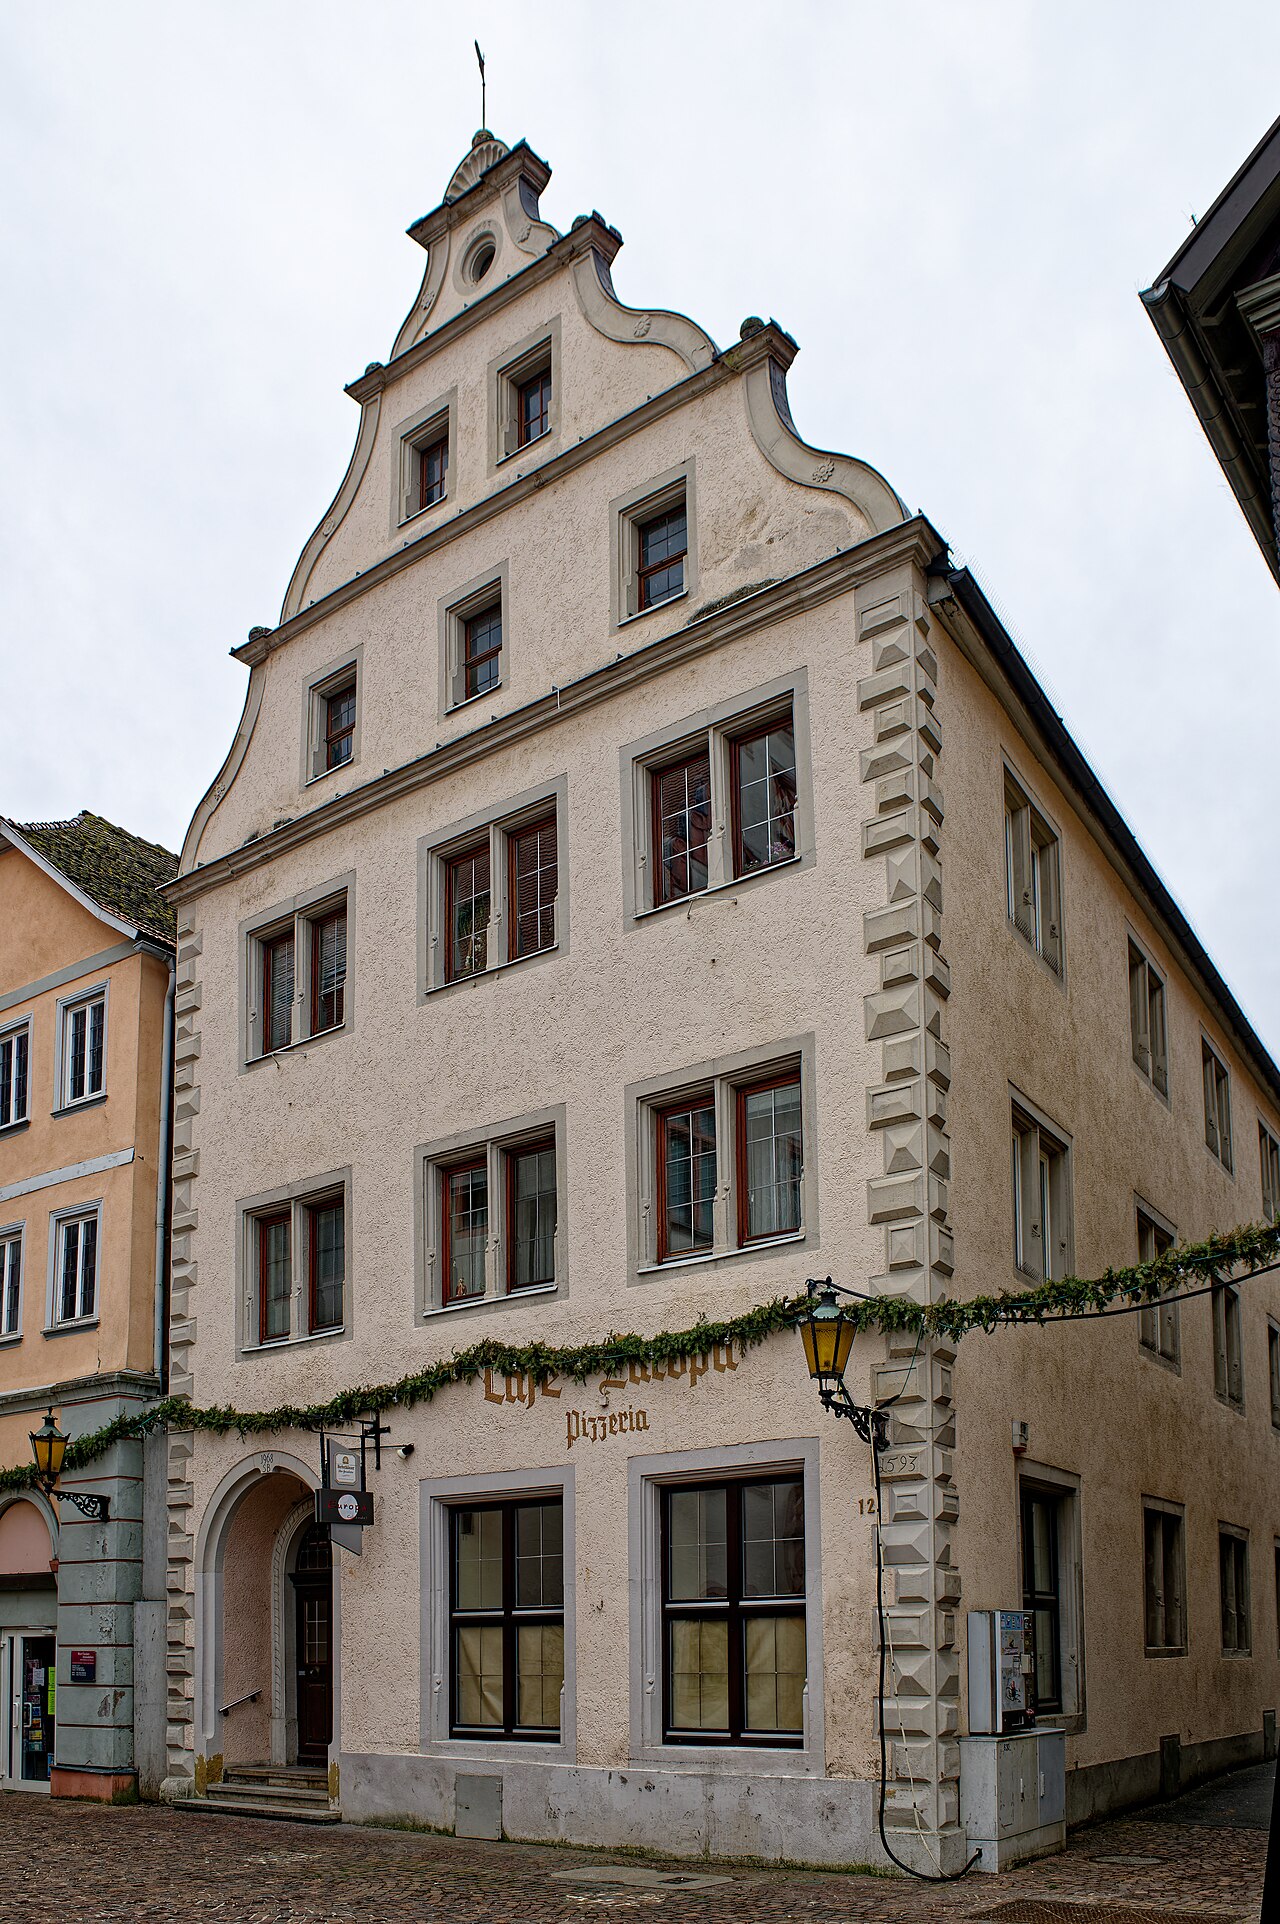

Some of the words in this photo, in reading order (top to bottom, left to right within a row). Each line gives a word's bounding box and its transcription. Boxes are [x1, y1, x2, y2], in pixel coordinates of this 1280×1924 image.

[565, 1404, 651, 1450] Pizzeria
[260, 1453, 274, 1465] 1968
[858, 1498, 876, 1515] 12
